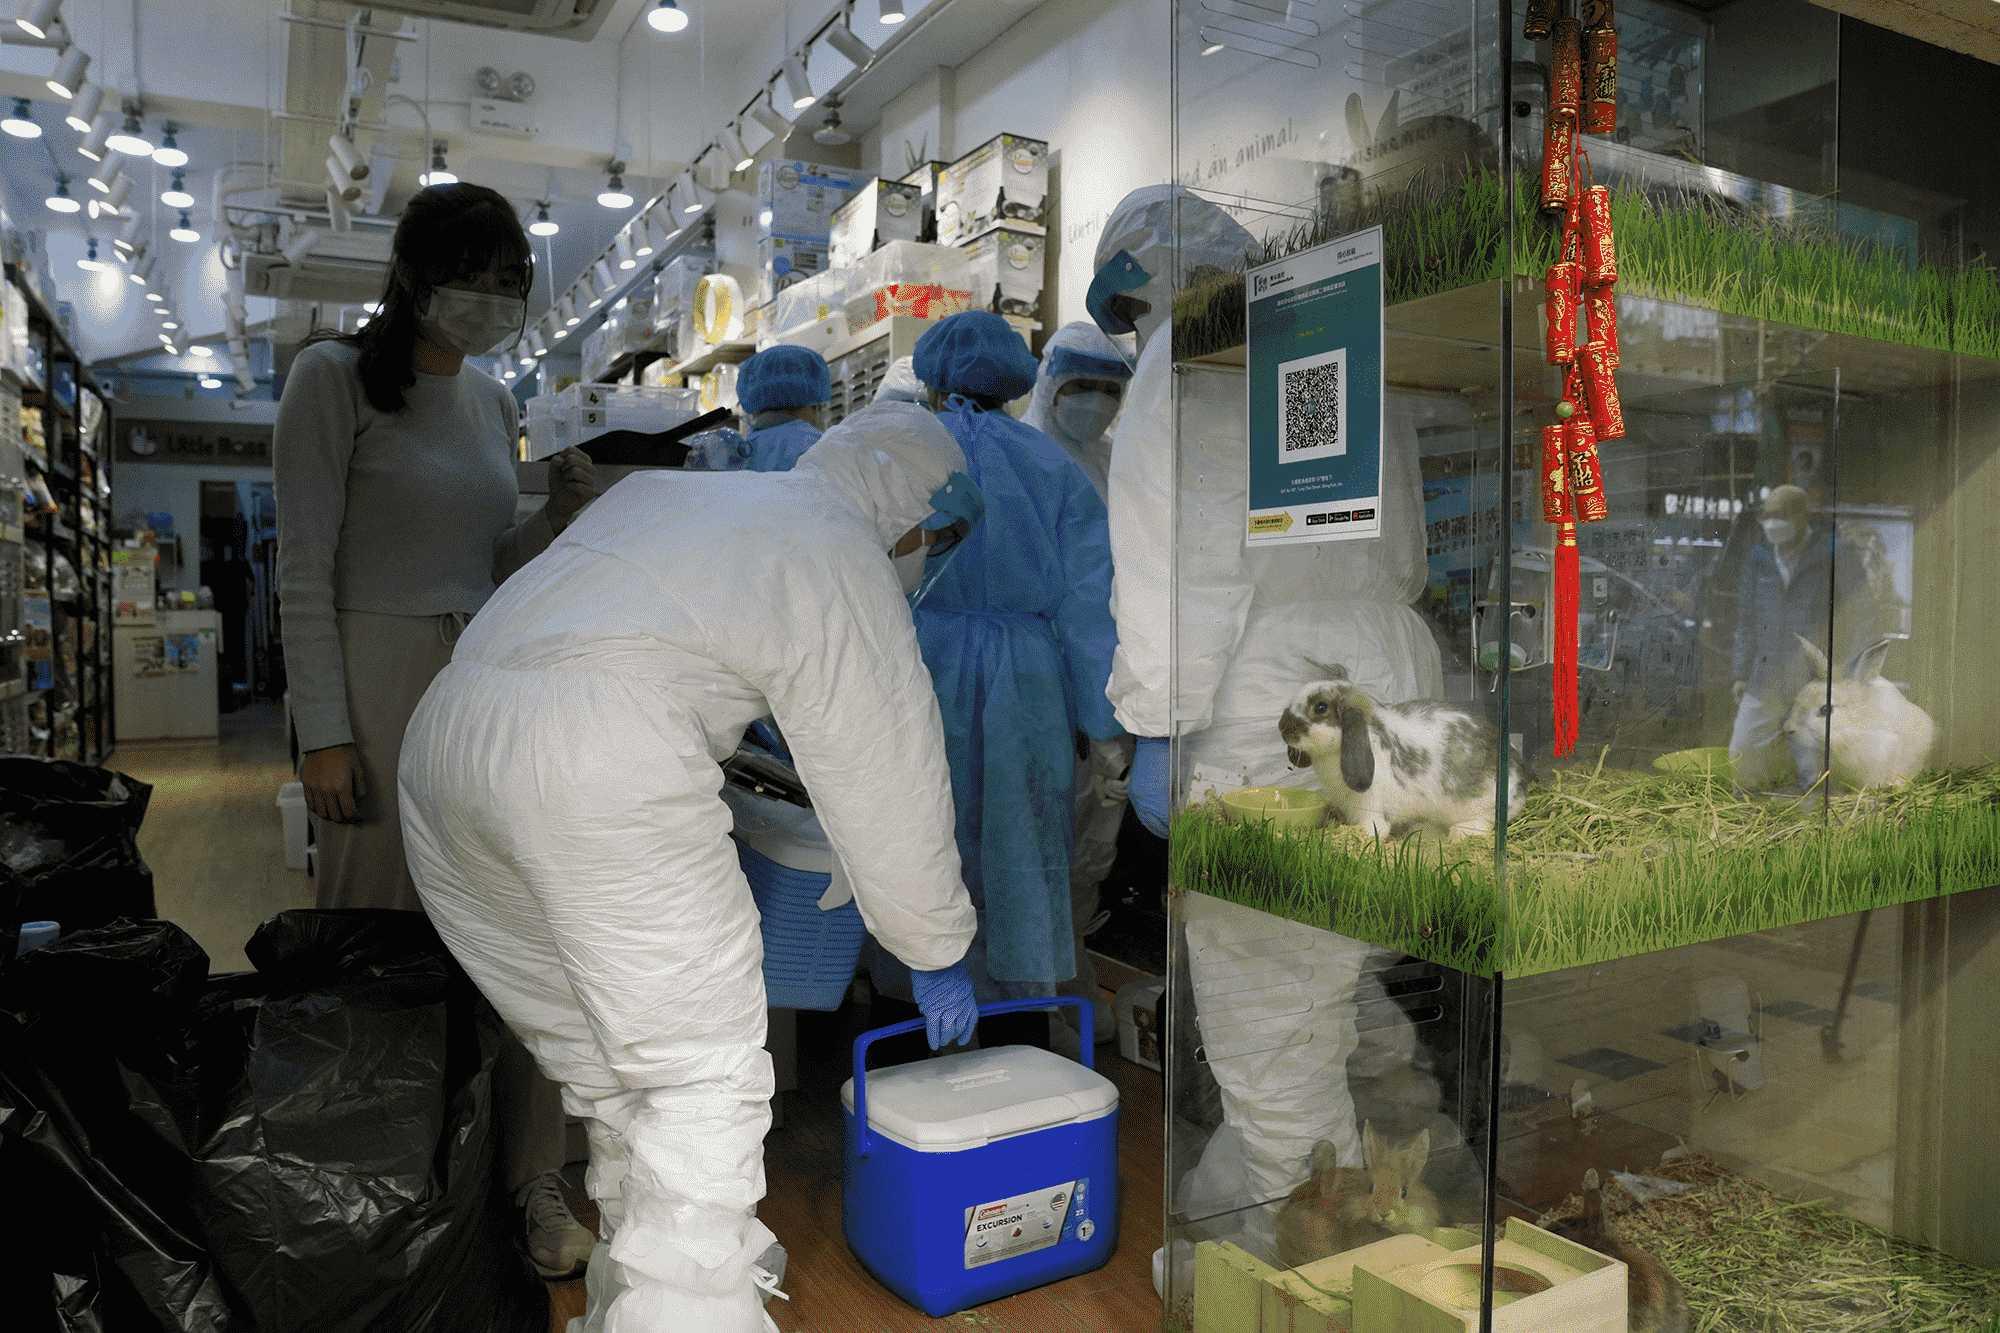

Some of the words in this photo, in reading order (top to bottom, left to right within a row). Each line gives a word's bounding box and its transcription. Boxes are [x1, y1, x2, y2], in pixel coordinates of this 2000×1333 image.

[1235, 116, 1298, 168] animal,
[590, 391, 600, 404] 4
[588, 413, 597, 424] 5
[976, 1214, 1023, 1232] EXCURSION
